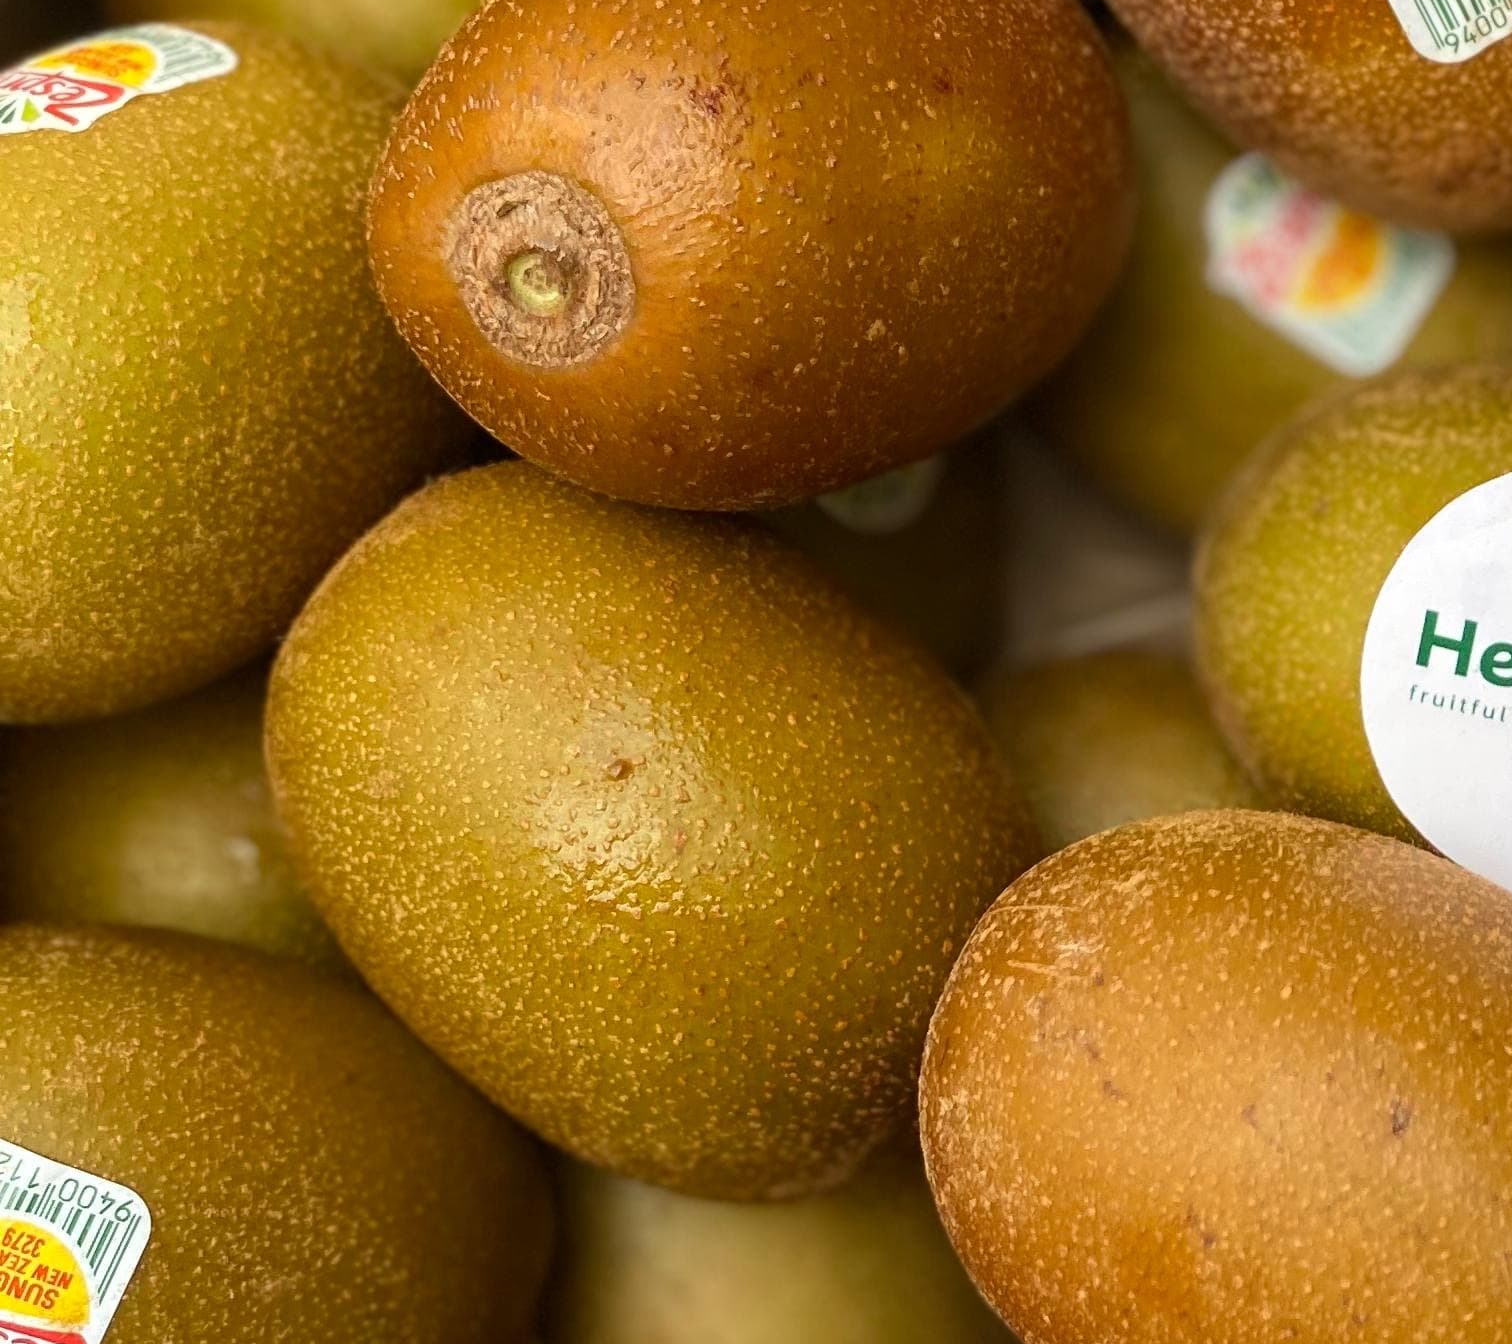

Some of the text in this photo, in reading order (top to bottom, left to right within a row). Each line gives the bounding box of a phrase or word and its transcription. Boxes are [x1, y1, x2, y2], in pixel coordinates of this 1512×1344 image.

[1444, 7, 1508, 54] 9400
[1409, 684, 1508, 723] fruitful
[0, 1151, 134, 1223] 9400 112
[2, 1227, 46, 1258] 3279
[31, 1263, 74, 1290] NEW
